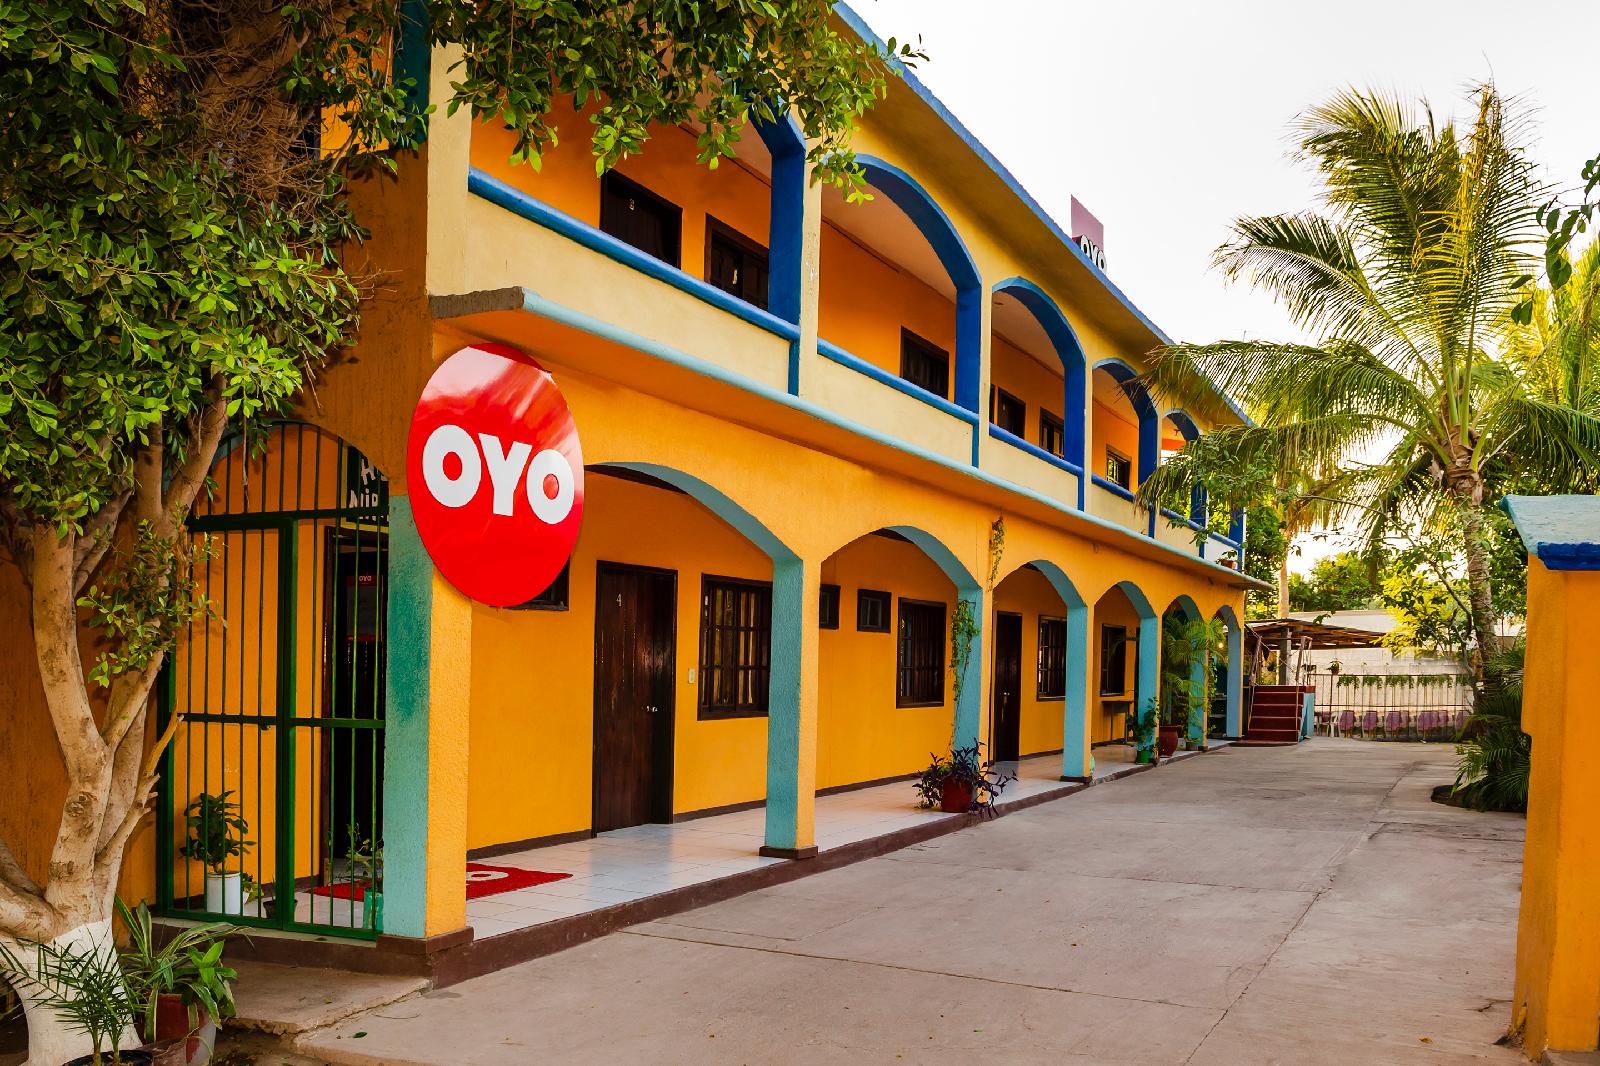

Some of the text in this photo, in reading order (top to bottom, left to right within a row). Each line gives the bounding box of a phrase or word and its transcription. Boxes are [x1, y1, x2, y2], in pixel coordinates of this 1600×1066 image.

[1080, 234, 1107, 275] OYO
[422, 424, 575, 525] OYO
[616, 594, 623, 607] 4
